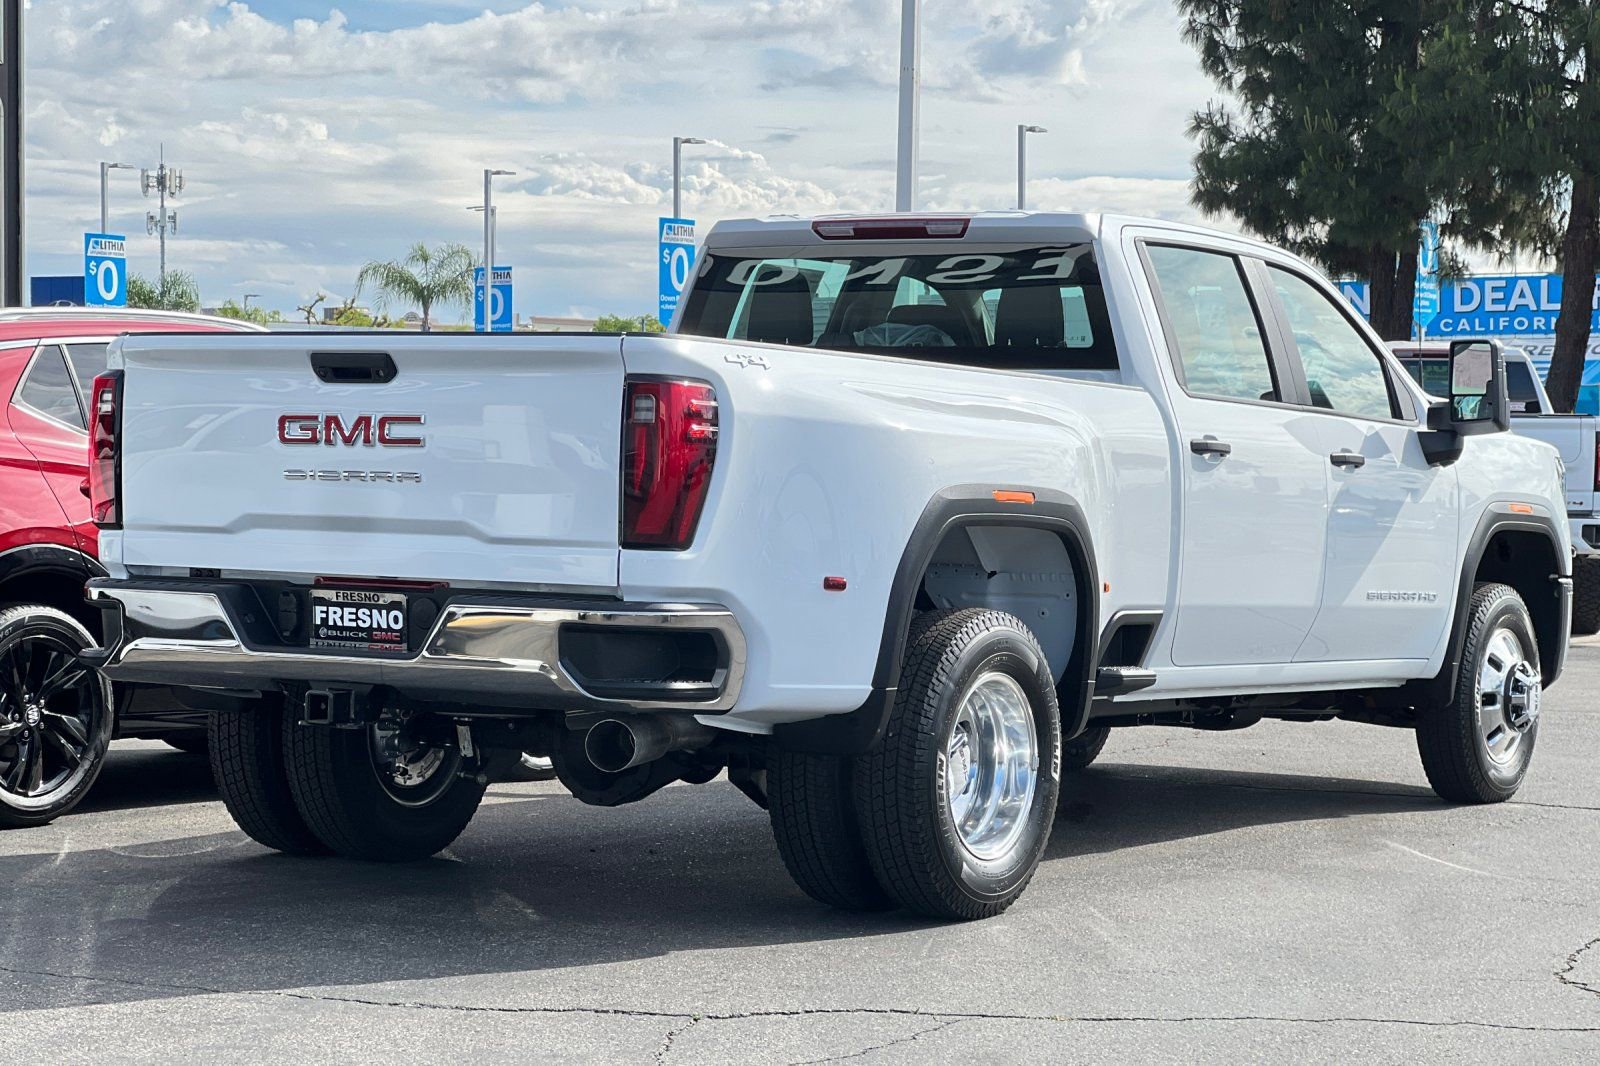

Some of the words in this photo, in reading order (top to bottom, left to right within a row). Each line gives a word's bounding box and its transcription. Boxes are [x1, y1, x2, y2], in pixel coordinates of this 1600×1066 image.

[673, 225, 694, 237] LITHIA
[100, 240, 125, 252] LITHIA
[89, 260, 119, 301] $0
[492, 271, 512, 280] THIA
[1453, 279, 1600, 313] DEAL
[1440, 316, 1596, 332] CALIFOR
[277, 411, 426, 447] GMC
[283, 468, 423, 483] SIERRA
[335, 591, 380, 603] FRESNO
[315, 605, 404, 630] FRESNO
[328, 629, 368, 638] BUICK
[372, 631, 401, 641] GMC
